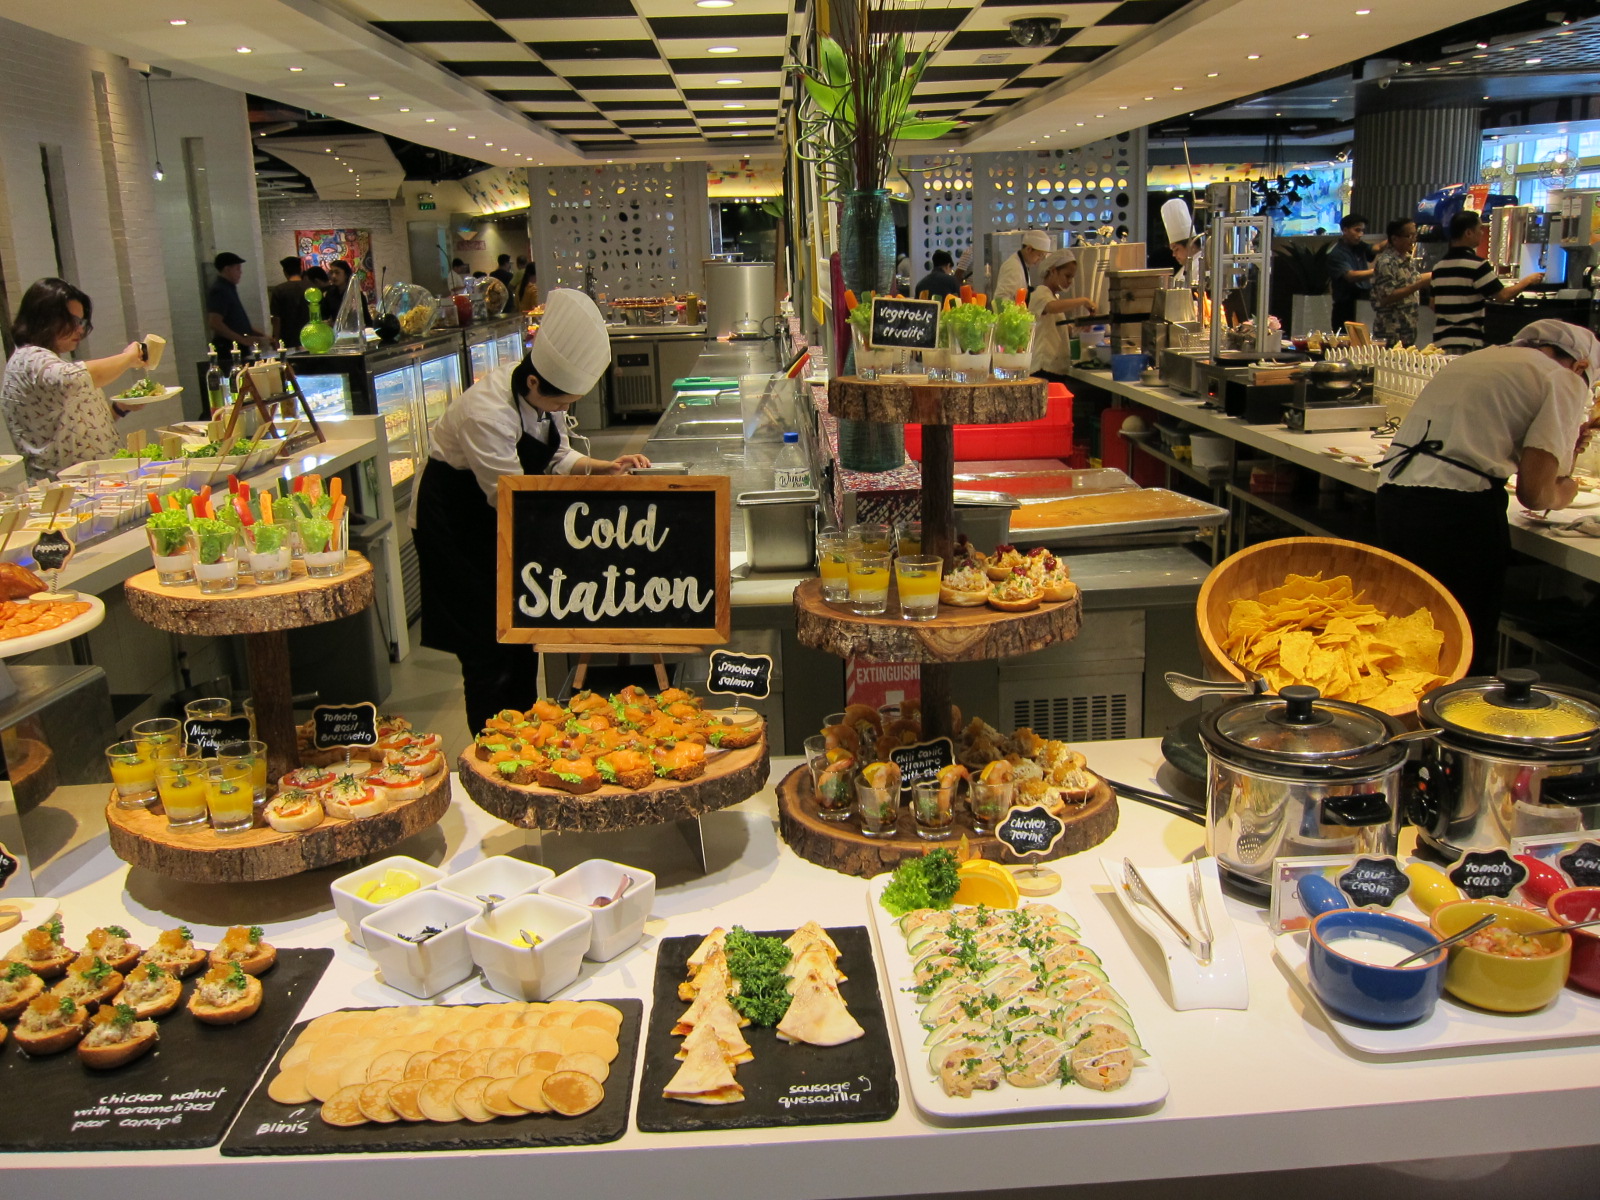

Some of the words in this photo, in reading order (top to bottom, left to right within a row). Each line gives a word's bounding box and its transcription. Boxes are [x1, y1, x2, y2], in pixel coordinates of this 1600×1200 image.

[564, 502, 669, 552] Cold
[519, 562, 714, 622] Station
[856, 664, 920, 684] EXTINGUISH
[1465, 861, 1512, 876] tomato
[1574, 858, 1600, 871] oni
[170, 1087, 227, 1101] walnut
[789, 1081, 851, 1094] sausage
[778, 1091, 861, 1109] quesadilla
[73, 1105, 111, 1117] with
